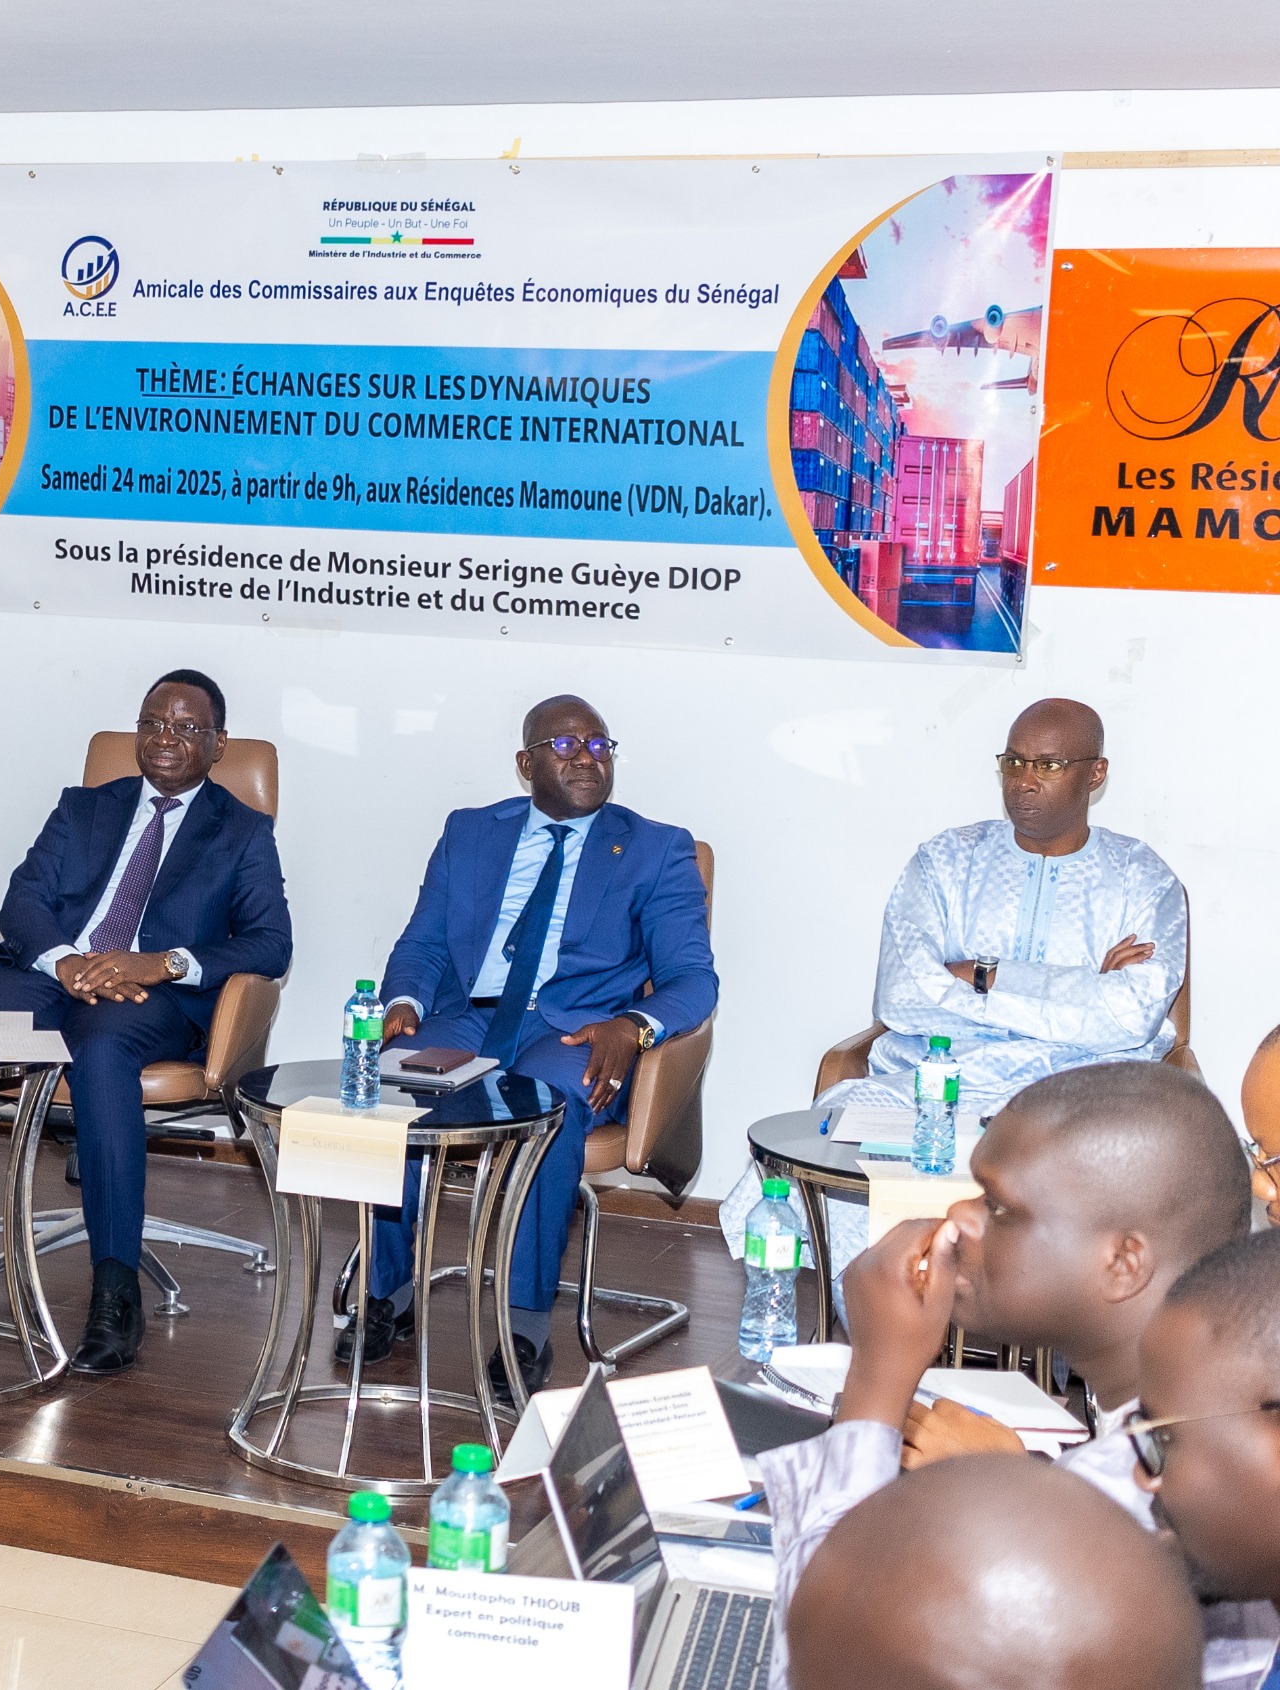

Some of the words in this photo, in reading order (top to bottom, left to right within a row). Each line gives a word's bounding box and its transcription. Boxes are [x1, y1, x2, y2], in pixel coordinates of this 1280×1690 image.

[323, 199, 397, 212] RÉPUBLIQUE
[400, 202, 418, 212] DU
[420, 198, 476, 212] SÉNÉGAL
[328, 218, 343, 228] Un
[345, 218, 379, 230] Peuple
[388, 219, 403, 229] Un
[405, 219, 422, 229] But
[430, 219, 451, 229] Une
[308, 250, 347, 259] Ministère
[349, 251, 360, 259] de
[362, 250, 407, 259] l'Industrie
[420, 251, 432, 259] du
[434, 251, 482, 260] Commerce
[132, 279, 204, 299] Amicale
[209, 280, 242, 300] des
[248, 279, 378, 301] Commissaires
[384, 286, 419, 301] aux
[424, 281, 515, 306] Enquêtes
[522, 278, 658, 309] Économiques
[665, 284, 690, 304] du
[697, 283, 780, 309] Sénégal
[63, 301, 117, 317] A.C.E.E
[231, 363, 361, 398] ÉCHANGES
[368, 373, 416, 400] SUR
[424, 375, 466, 401] LES
[471, 375, 651, 408] DYNAMIQUES
[49, 405, 77, 430] DE
[85, 406, 317, 436] L'ENVIRONNEMENT
[324, 411, 359, 437] DU
[370, 411, 512, 441] COMMERCE
[520, 416, 744, 448] INTERNATIONAL
[1117, 462, 1176, 490] Les
[1191, 460, 1280, 491] Rési
[41, 463, 107, 492] Samedi
[112, 466, 134, 493] 24
[138, 467, 172, 495] mai
[177, 469, 227, 500] 2025,
[231, 469, 242, 497] à
[247, 471, 300, 504] partir
[304, 472, 328, 500] de
[332, 473, 362, 506] 9h,
[366, 481, 401, 504] aux
[406, 476, 514, 508] Résidences
[520, 480, 622, 512] Mamoune
[627, 484, 688, 518] (VDN,
[694, 485, 773, 521] Dakar).
[54, 538, 111, 562] Sous
[118, 541, 139, 564] la
[146, 543, 283, 570] présidence
[289, 549, 321, 572] de
[327, 551, 451, 579] Monsieur
[458, 557, 564, 588] Serigne
[571, 562, 660, 594] Guèye
[669, 566, 742, 591] DIOP
[130, 572, 233, 599] Ministre
[240, 577, 271, 601] de
[417, 590, 443, 610] et
[450, 588, 485, 613] du
[492, 591, 641, 620] Commerce
[435, 1586, 516, 1605] Moustapha
[523, 1596, 581, 1613] THIOUB
[425, 1603, 472, 1619] Expert
[477, 1612, 494, 1622] en
[499, 1615, 565, 1631] politique
[447, 1628, 539, 1647] commerciale
